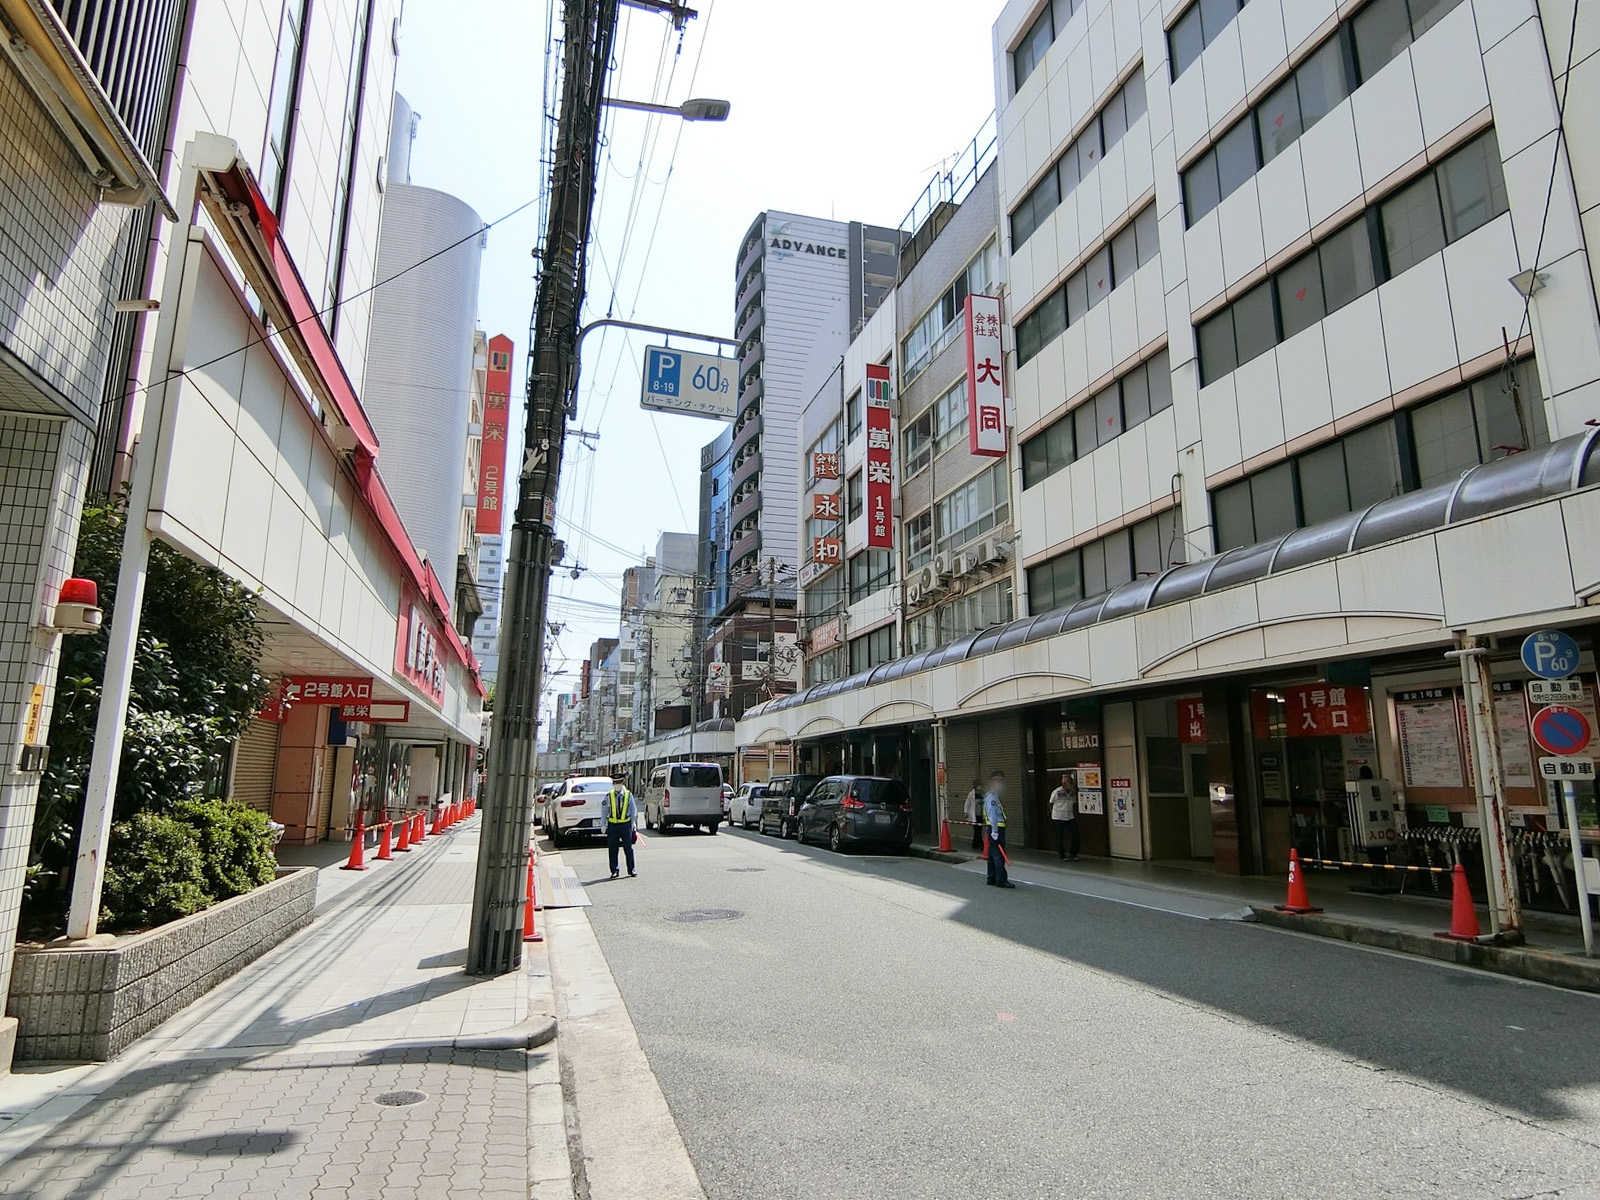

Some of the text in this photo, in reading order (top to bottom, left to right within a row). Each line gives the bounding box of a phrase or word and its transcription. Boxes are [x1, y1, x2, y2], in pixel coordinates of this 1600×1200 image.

[771, 238, 847, 259] ADVANCE
[658, 354, 675, 378] P
[653, 380, 674, 393] 8-19
[976, 357, 1001, 434] 大同
[815, 494, 839, 561] 永和
[1534, 642, 1556, 671] P
[304, 682, 369, 699] 2号館入口
[1532, 682, 1581, 693] 自動車
[1299, 688, 1347, 709] 1号館
[343, 705, 369, 717] 萬栄
[1301, 711, 1348, 730] 入口
[1543, 762, 1592, 775] 自動車
